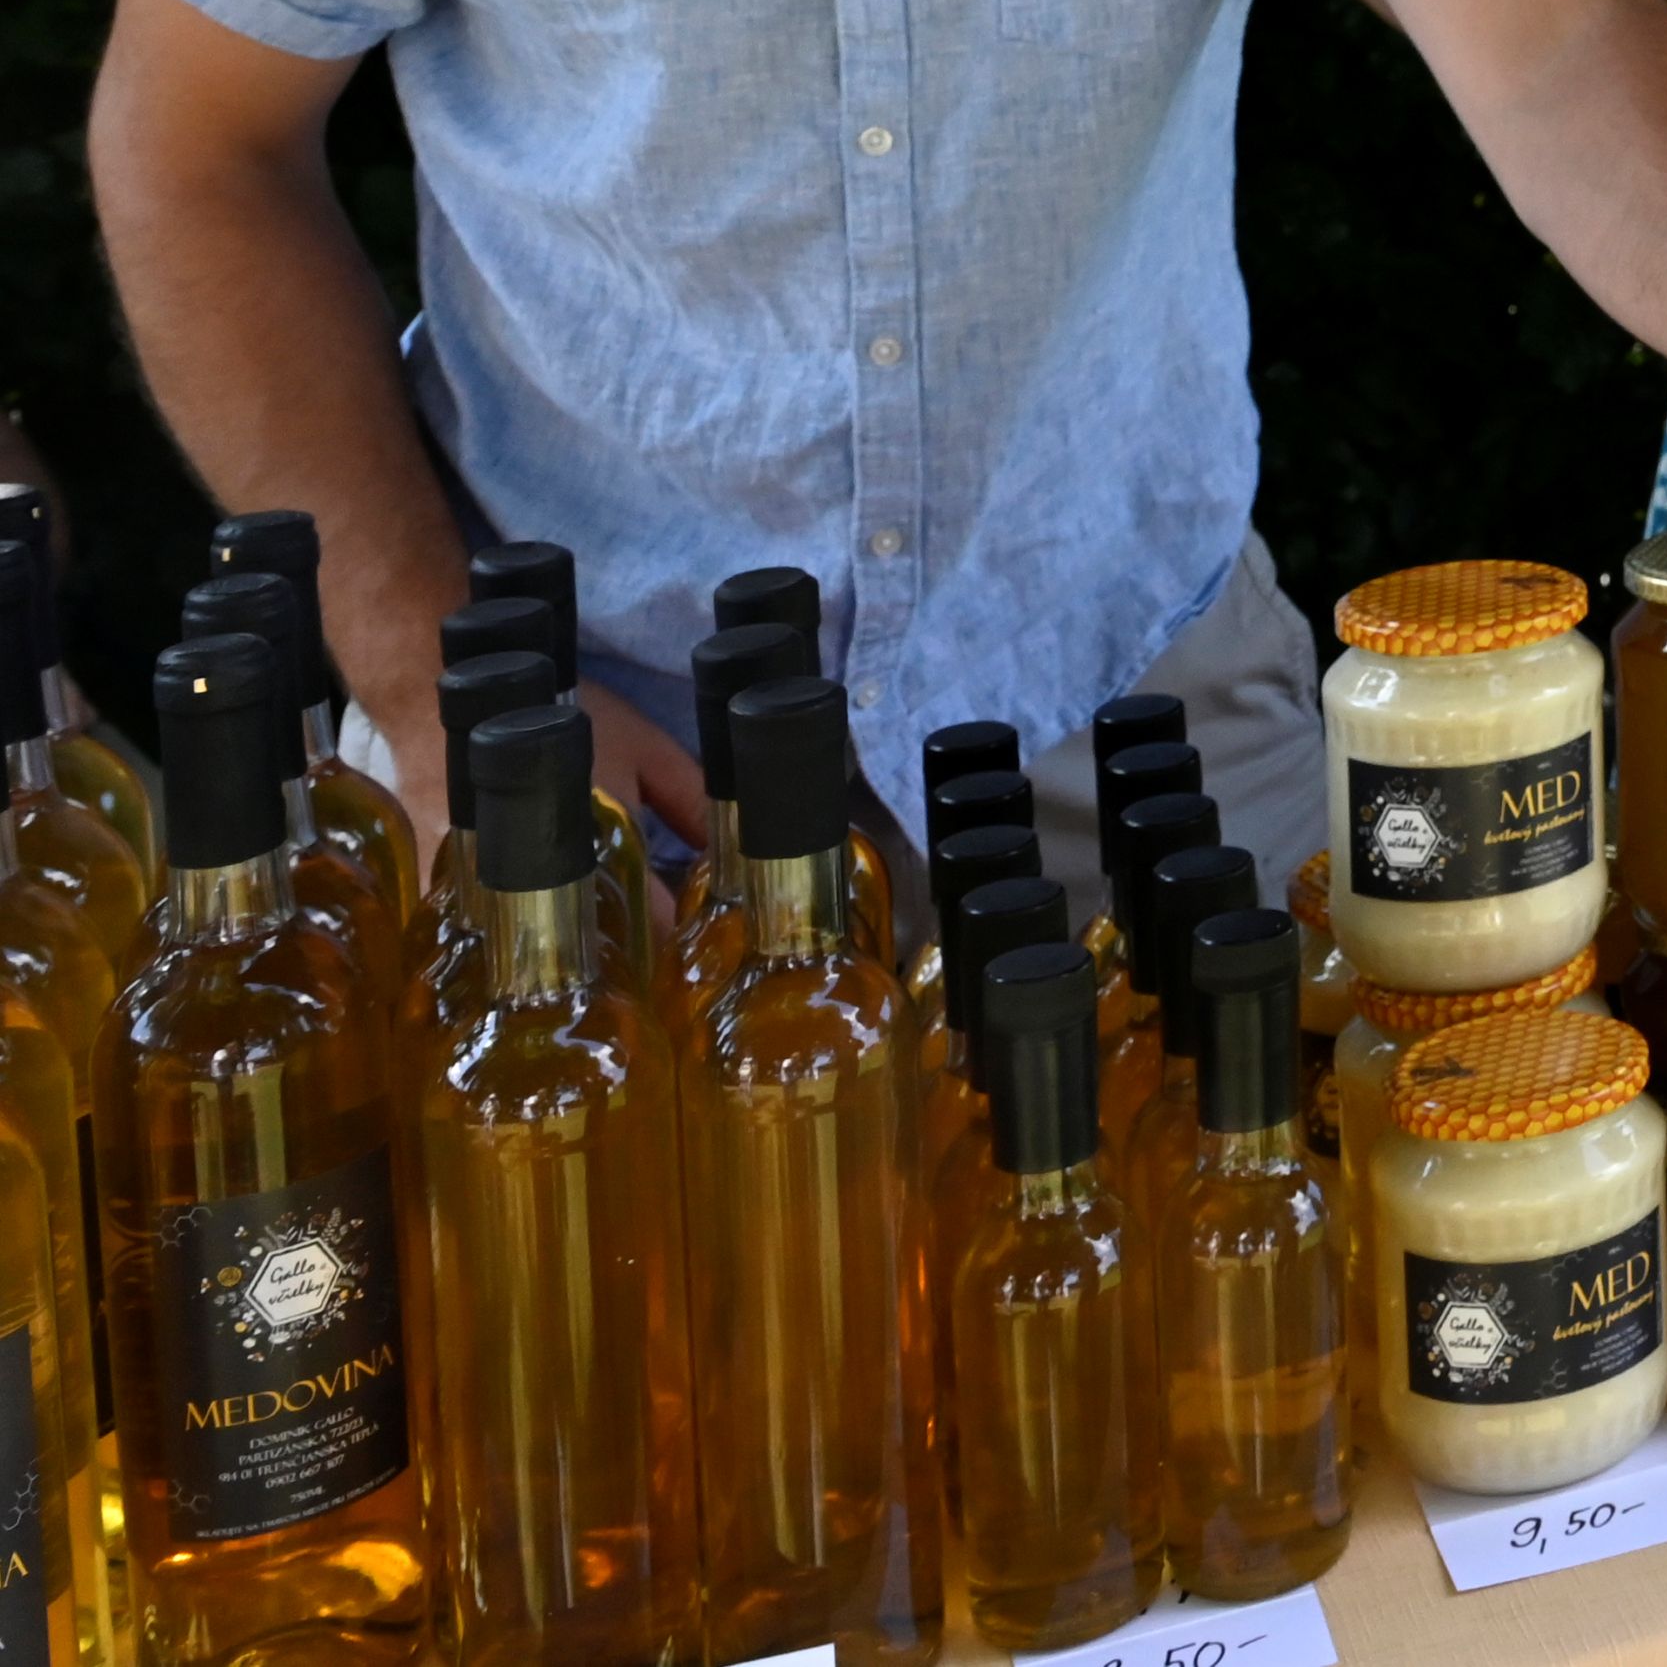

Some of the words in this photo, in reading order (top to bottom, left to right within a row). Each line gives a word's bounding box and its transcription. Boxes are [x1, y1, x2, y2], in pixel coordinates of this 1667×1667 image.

[1500, 770, 1581, 823] MED
[269, 1279, 325, 1305] včielky
[270, 1258, 316, 1285] Gallo
[1570, 1251, 1650, 1316] MED
[185, 1343, 394, 1431] MEDOVINA
